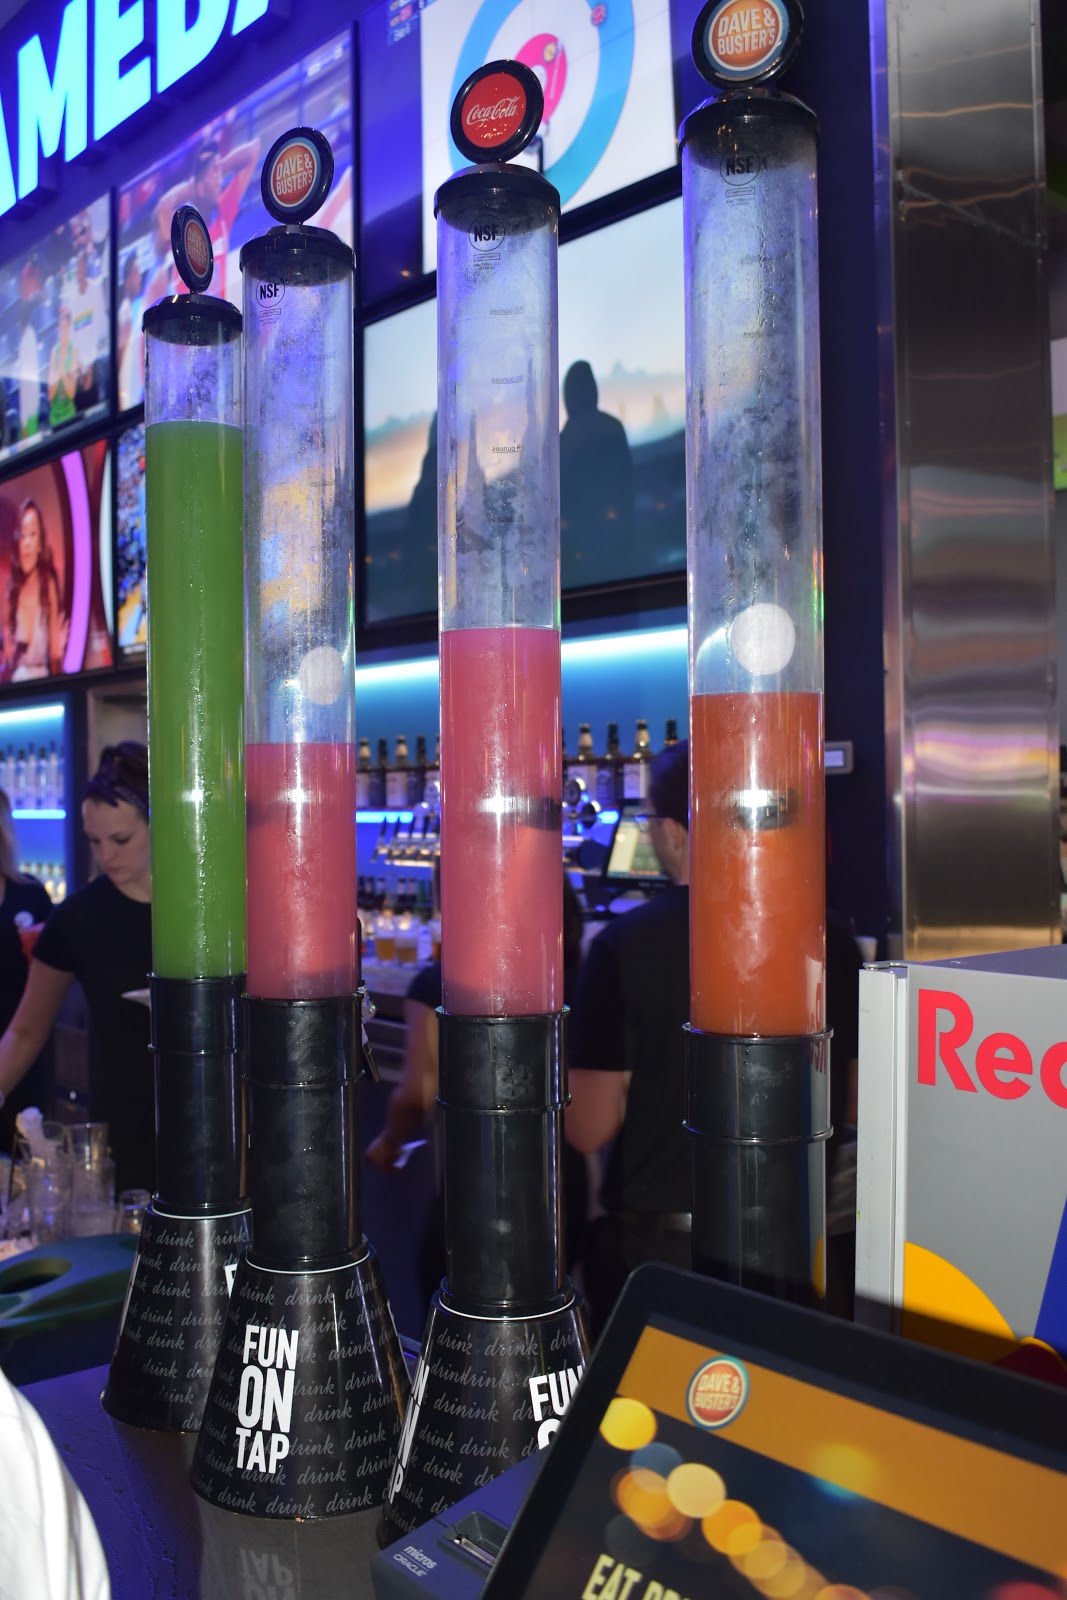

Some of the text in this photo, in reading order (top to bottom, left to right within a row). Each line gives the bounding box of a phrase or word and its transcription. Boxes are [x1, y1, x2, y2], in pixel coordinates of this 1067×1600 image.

[718, 7, 775, 38] DAVE &
[718, 28, 775, 55] BUSTER'S
[276, 153, 312, 179] DAVE &
[276, 170, 313, 196] BUSTER'S
[474, 225, 498, 242] NSF
[259, 282, 280, 300] NSF
[157, 1228, 194, 1248] drink
[152, 1278, 191, 1299] drink
[240, 1280, 275, 1305] drink
[285, 1286, 336, 1306] drink
[141, 1306, 173, 1327] drink
[181, 1308, 223, 1327] drink
[299, 1313, 348, 1334] drink
[146, 1329, 185, 1350] drink
[242, 1324, 299, 1371] FUN
[484, 1333, 539, 1357] drink
[143, 1358, 178, 1379] drink
[697, 1372, 740, 1393] DAVE &
[237, 1364, 295, 1433] ON
[304, 1398, 353, 1423] drink
[235, 1427, 291, 1474] TAP
[289, 1434, 334, 1456] drink
[344, 1422, 386, 1451] drink
[418, 1423, 455, 1453] drink
[459, 1436, 510, 1459] drink
[205, 1448, 234, 1477] drink
[297, 1461, 347, 1485] drink
[356, 1446, 396, 1477] drink
[422, 1455, 464, 1485] drink
[218, 1485, 256, 1512] drink
[266, 1495, 315, 1516] drink
[325, 1484, 374, 1513] drink
[393, 1553, 427, 1577] ORACLE
[403, 1545, 438, 1569] micros
[581, 1552, 643, 1600] EAT
